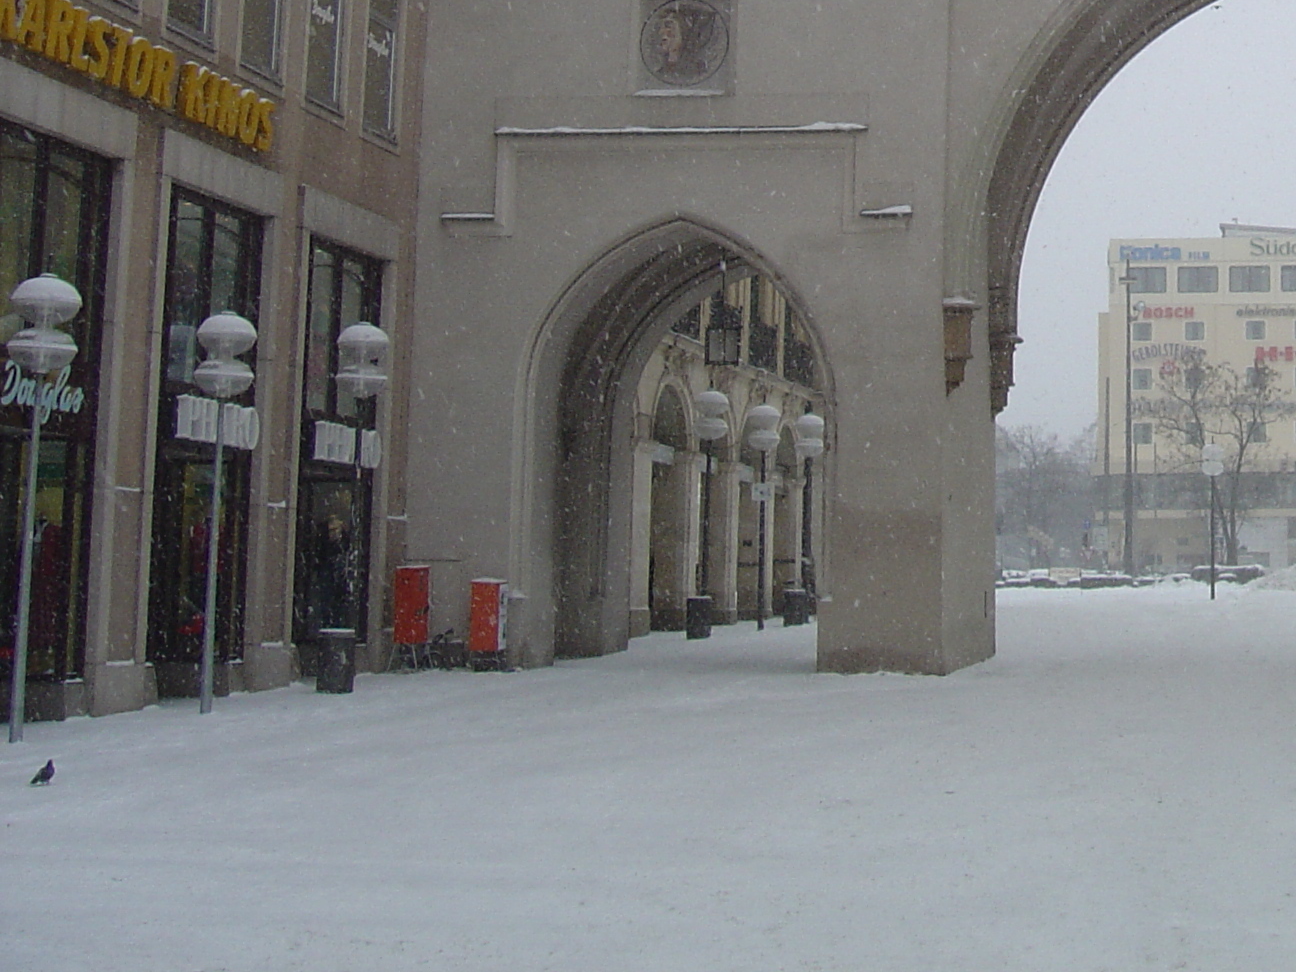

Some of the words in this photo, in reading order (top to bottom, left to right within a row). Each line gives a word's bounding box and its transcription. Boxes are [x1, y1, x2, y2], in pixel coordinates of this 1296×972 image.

[178, 60, 276, 152] KINOS
[1119, 244, 1181, 261] Konica
[1143, 306, 1194, 319] BOSCH
